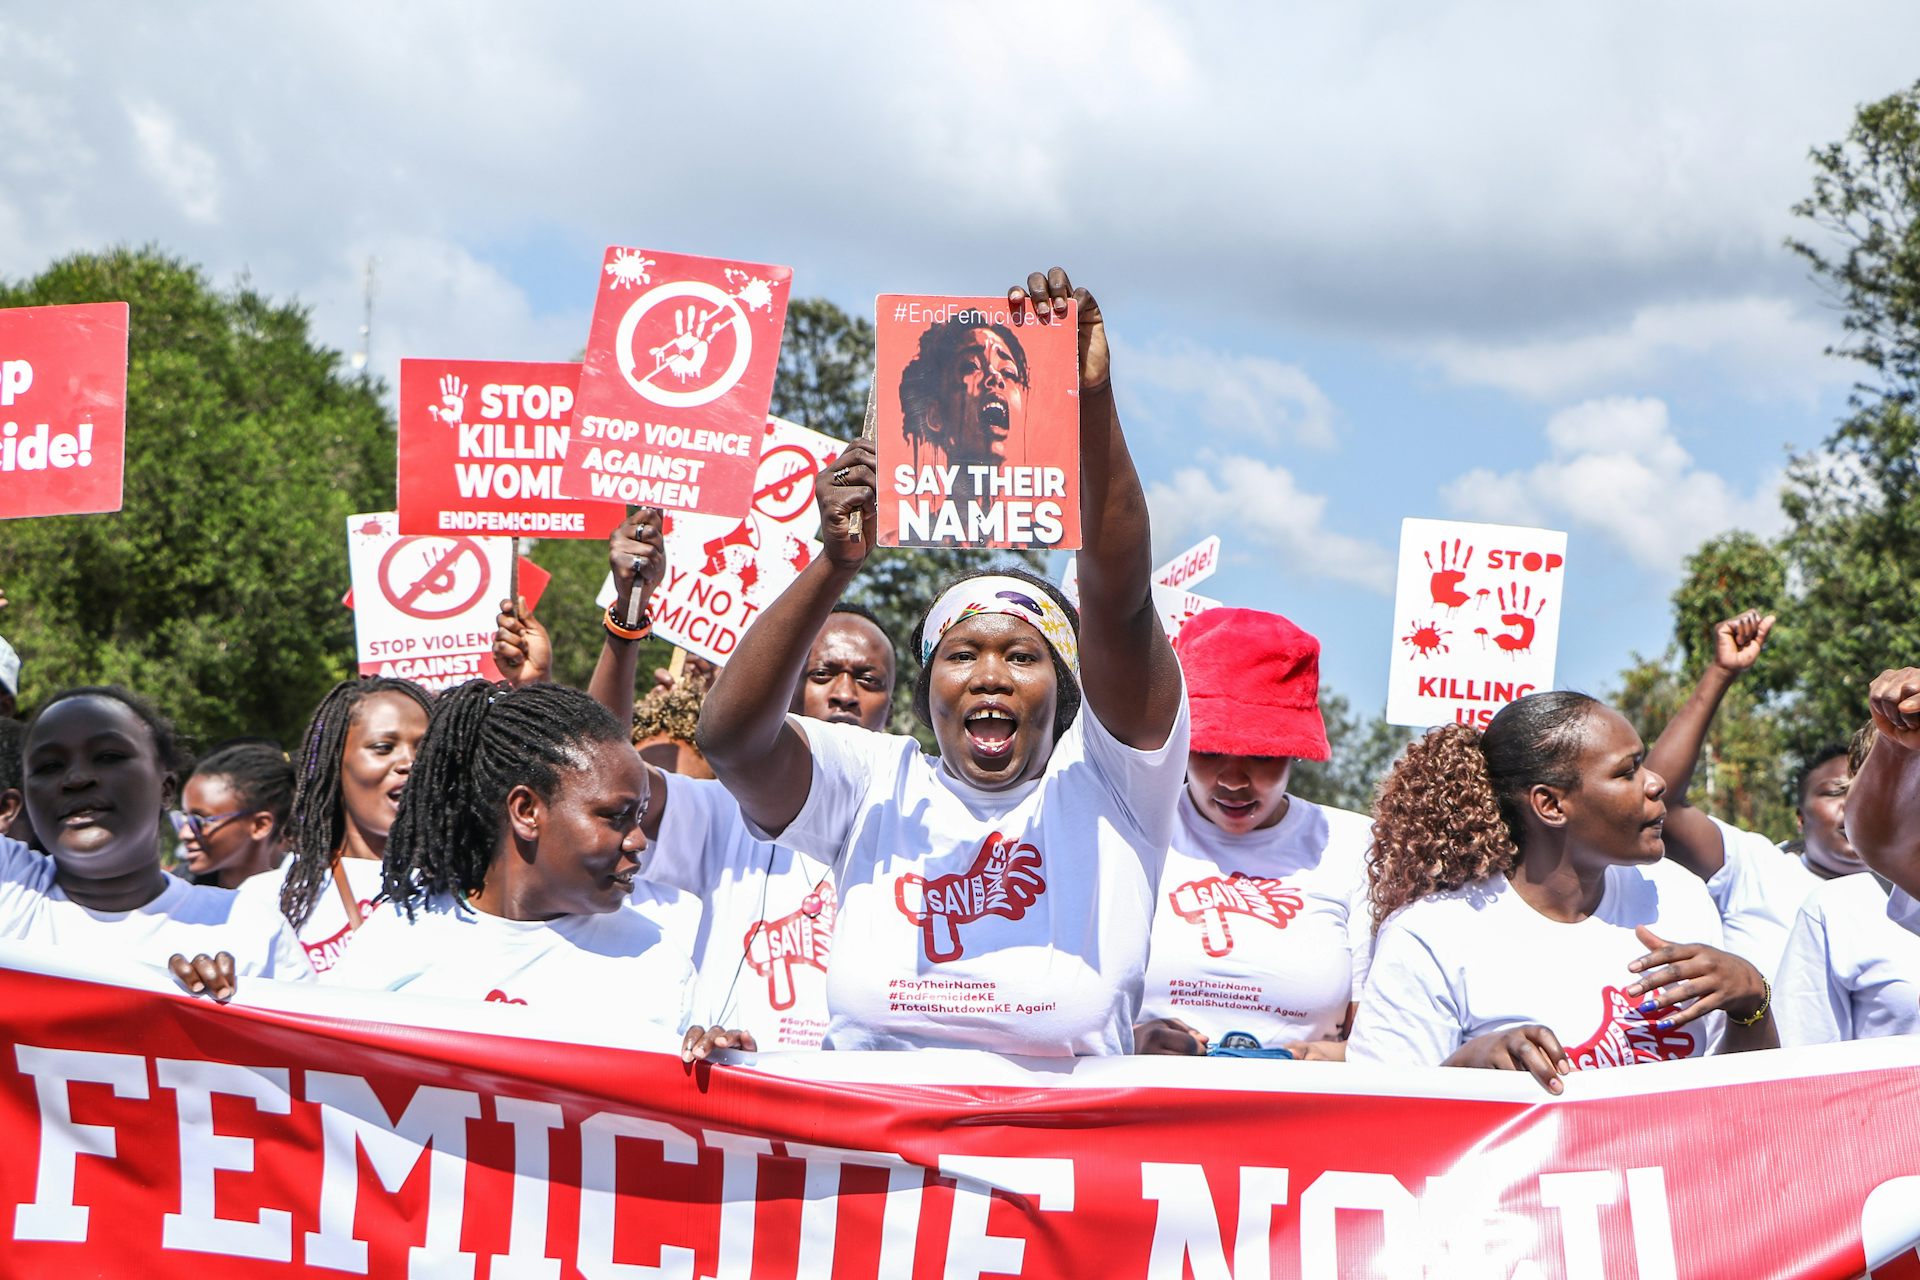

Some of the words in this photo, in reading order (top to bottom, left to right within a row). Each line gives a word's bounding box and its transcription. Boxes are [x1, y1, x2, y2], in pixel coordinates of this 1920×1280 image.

[480, 383, 574, 420] STOP
[0, 421, 93, 471] ide!
[458, 423, 570, 460] KILLIN
[580, 415, 640, 441] STOP
[644, 423, 752, 456] VIOLENCE
[454, 463, 573, 499] WOM
[581, 447, 705, 482] AGAINST
[894, 464, 961, 497] SAY
[967, 465, 1066, 497] THEIR
[591, 473, 700, 508] WOMEN
[438, 511, 585, 531] ENDFEMICIDEKE
[898, 499, 1064, 544] NAMES
[1487, 549, 1563, 572] STOP
[687, 578, 732, 616] NO
[739, 601, 759, 627] T
[651, 593, 737, 655] MICID
[369, 638, 416, 655] STOP
[422, 631, 497, 650] VIOLEN
[379, 654, 482, 678] AGAINST
[927, 879, 971, 916] SAY
[1197, 881, 1237, 907] SAY
[768, 918, 803, 958] SAY
[889, 979, 996, 990] #SayTheirNames
[889, 992, 995, 1001] #EndFemicideKE
[1169, 979, 1263, 993] #SayTheirNames
[1170, 989, 1260, 1002] #EndFemicideKE
[780, 1017, 829, 1027] #SayTheir
[890, 1003, 1012, 1013] #TotalShutdownKE
[1016, 1002, 1057, 1014] Again!
[1171, 998, 1272, 1012] #TotalShutdownKE
[1274, 1007, 1308, 1018] Again!
